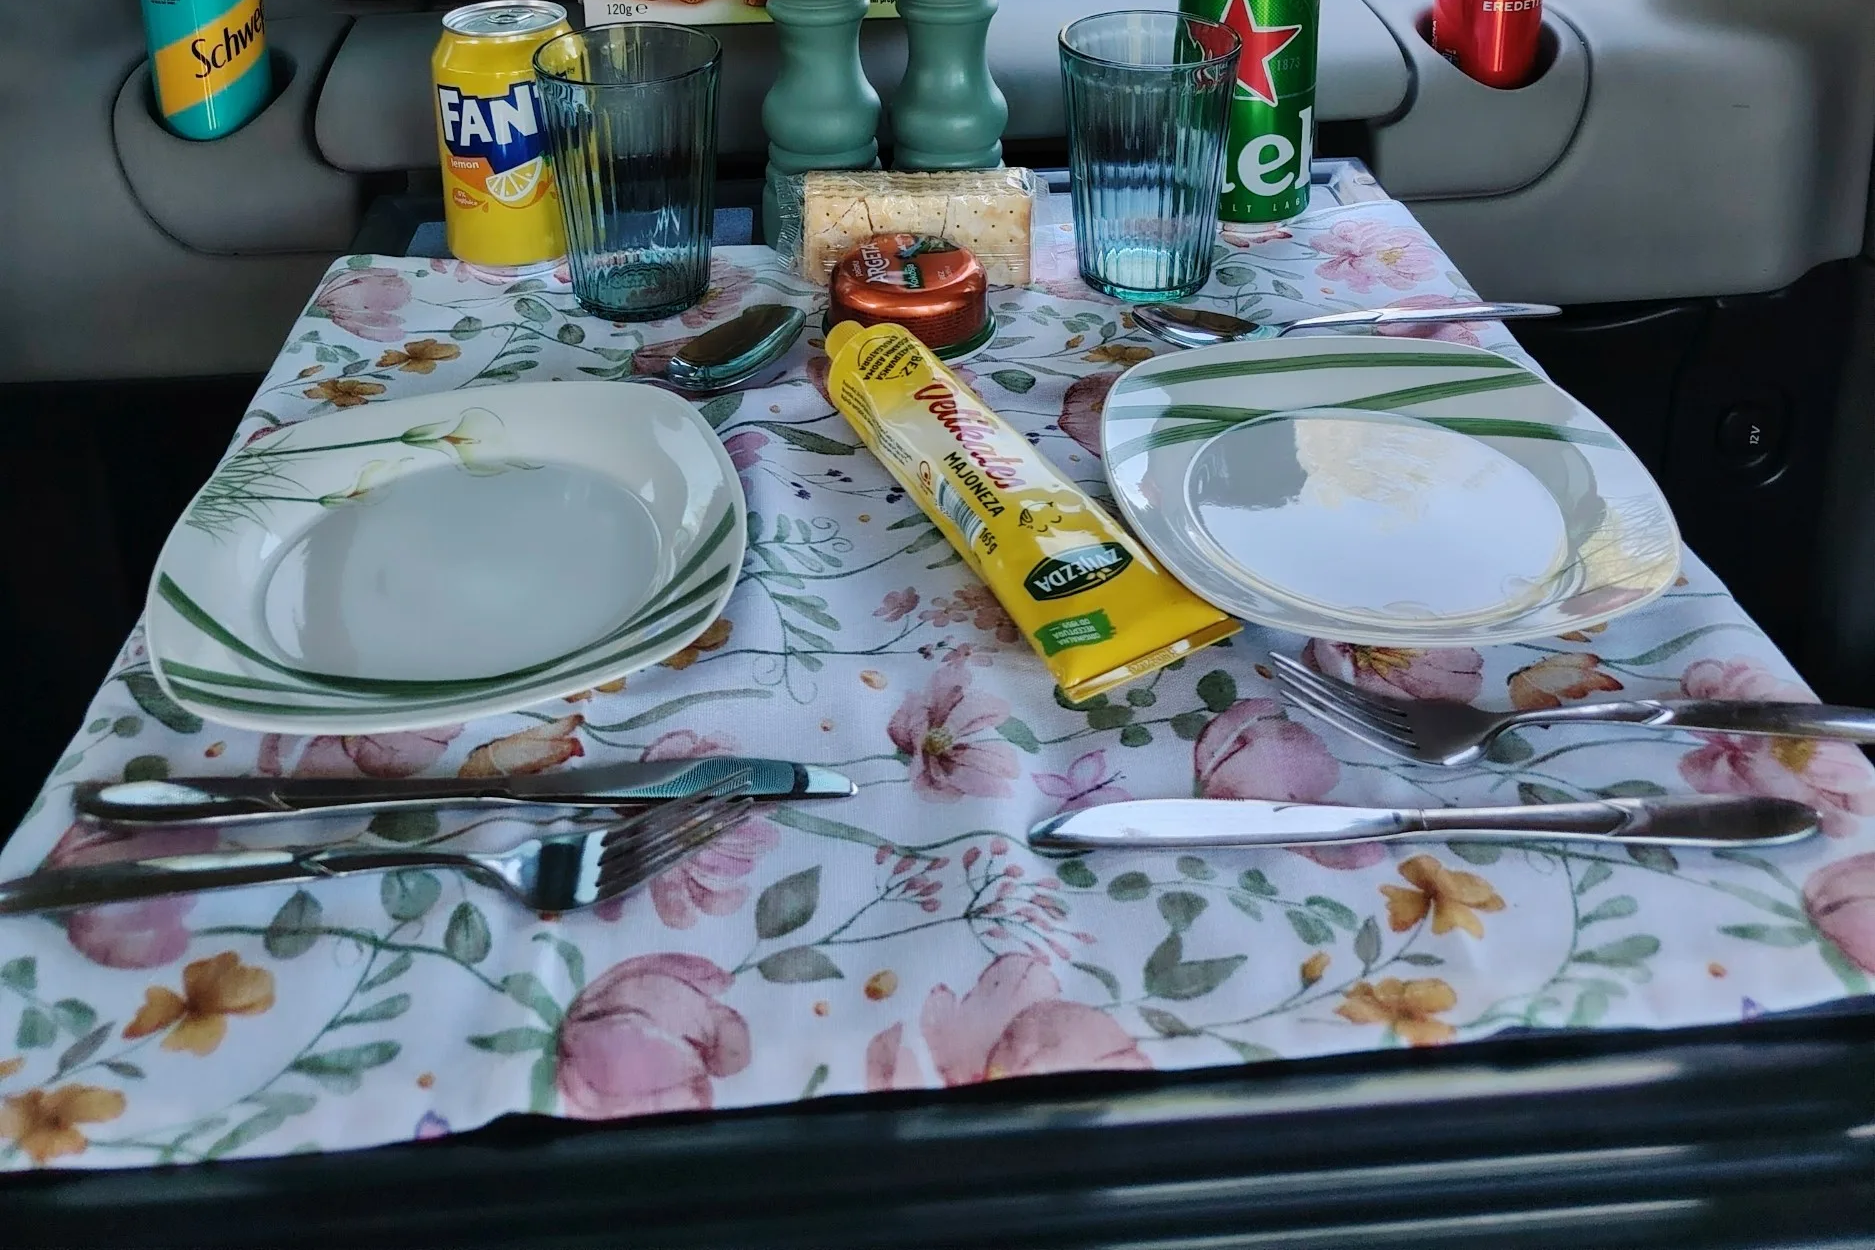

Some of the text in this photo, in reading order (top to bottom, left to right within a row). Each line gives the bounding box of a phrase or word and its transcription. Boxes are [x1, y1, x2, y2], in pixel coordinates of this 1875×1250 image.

[607, 3, 633, 17] 120g
[438, 84, 541, 146] FAN
[450, 157, 480, 169] lemon
[861, 242, 890, 285] ARGETA
[863, 356, 886, 381] AROMA
[899, 355, 923, 377] BEZ:
[1749, 425, 1761, 445] 12V
[943, 451, 1005, 518] MAJONEZA
[1034, 547, 1124, 593] ZVIJEZDA
[1051, 625, 1096, 639] RECEPTURA
